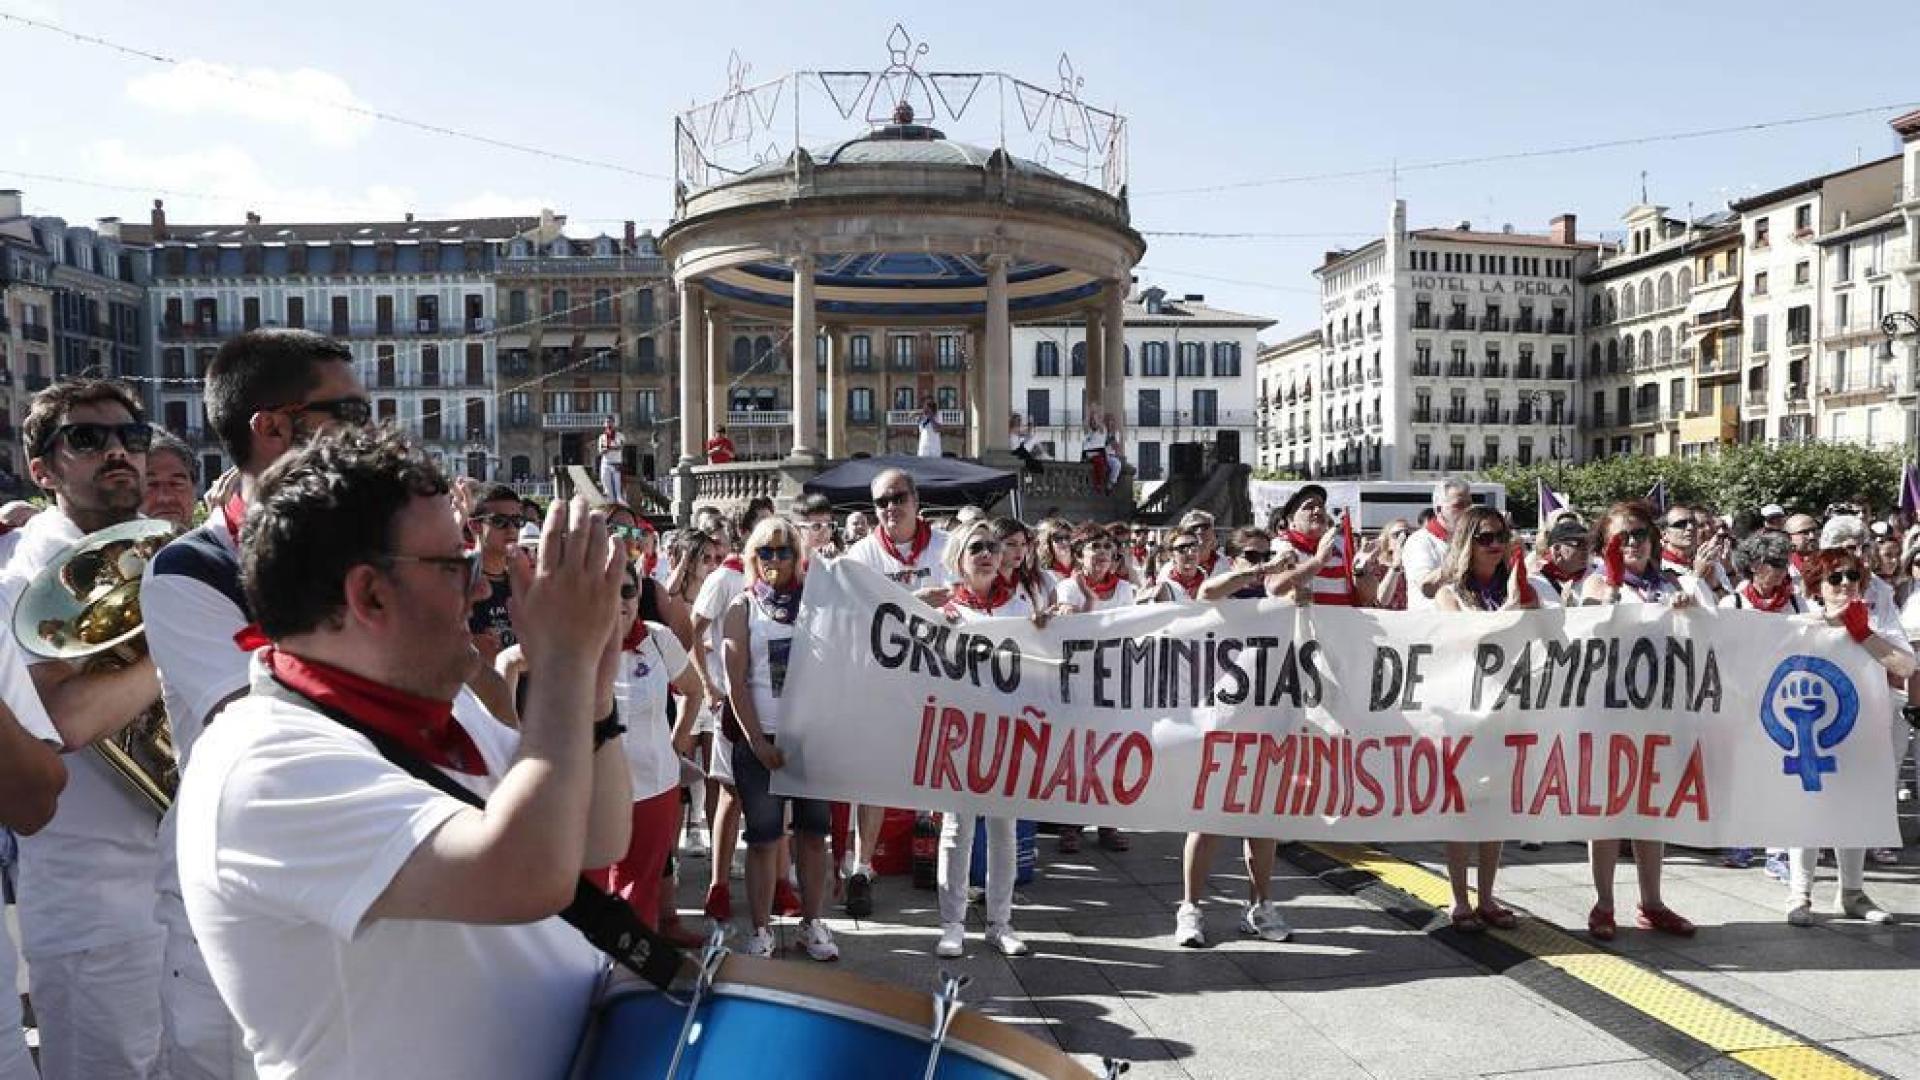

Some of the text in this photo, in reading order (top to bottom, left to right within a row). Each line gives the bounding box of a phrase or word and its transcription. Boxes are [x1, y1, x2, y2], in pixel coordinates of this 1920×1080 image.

[1411, 275, 1572, 297] HOTEL LA PERLA
[871, 602, 1722, 713] GRUPO FEMINISTAS DE PAMPLONA
[912, 695, 1710, 821] IRUÑAKO FEMINISTOK TALDEA
